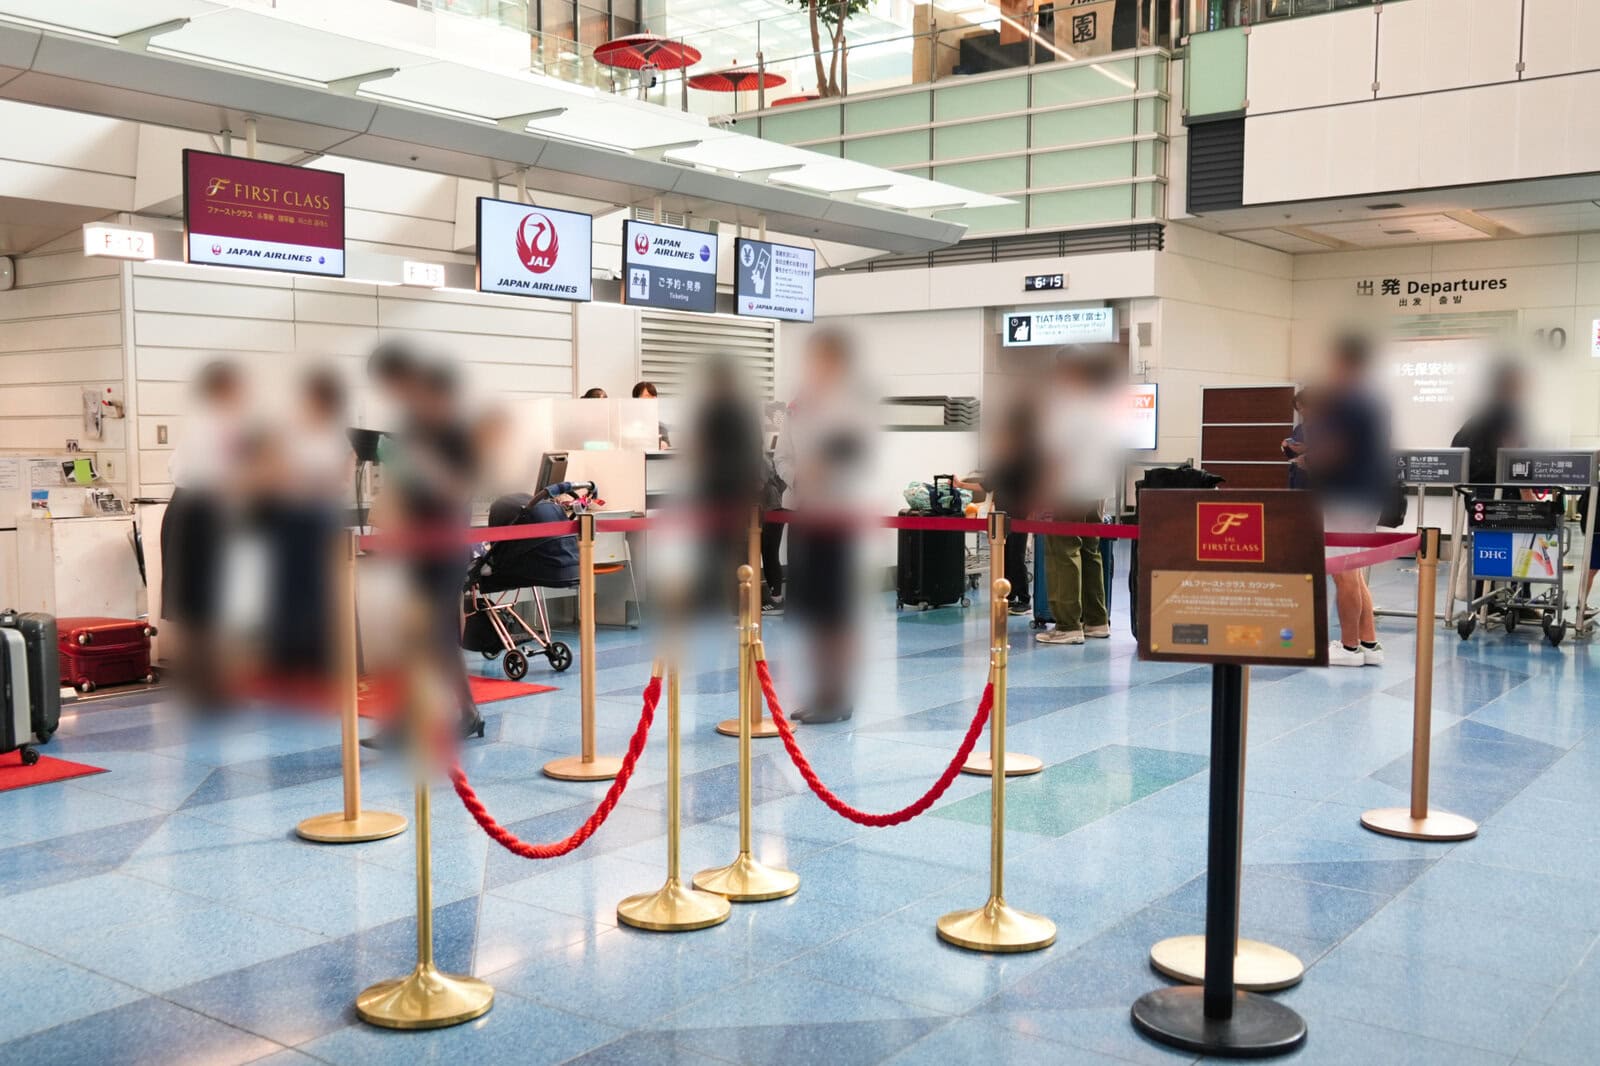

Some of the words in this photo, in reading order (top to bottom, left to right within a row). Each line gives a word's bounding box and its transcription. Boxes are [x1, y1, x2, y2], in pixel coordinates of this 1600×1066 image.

[1070, 0, 1097, 44] 園
[234, 184, 278, 203] FIRST
[283, 190, 330, 210] CLASS
[207, 206, 254, 218] ファーストクラス
[653, 237, 681, 248] JAPAN
[226, 247, 262, 258] JAPAN
[263, 250, 312, 263] AIRLINES
[654, 249, 695, 260] AIRLINES
[528, 256, 551, 268] JAL
[497, 278, 530, 289] JAPAN
[532, 282, 578, 294] AIRLINES
[658, 277, 701, 292] ご予約・発券
[1034, 276, 1062, 288] 6:15
[1407, 277, 1507, 296] Departures
[670, 292, 689, 301] Ticketing
[1230, 544, 1259, 552] CLASS
[1480, 550, 1507, 559] DHC
